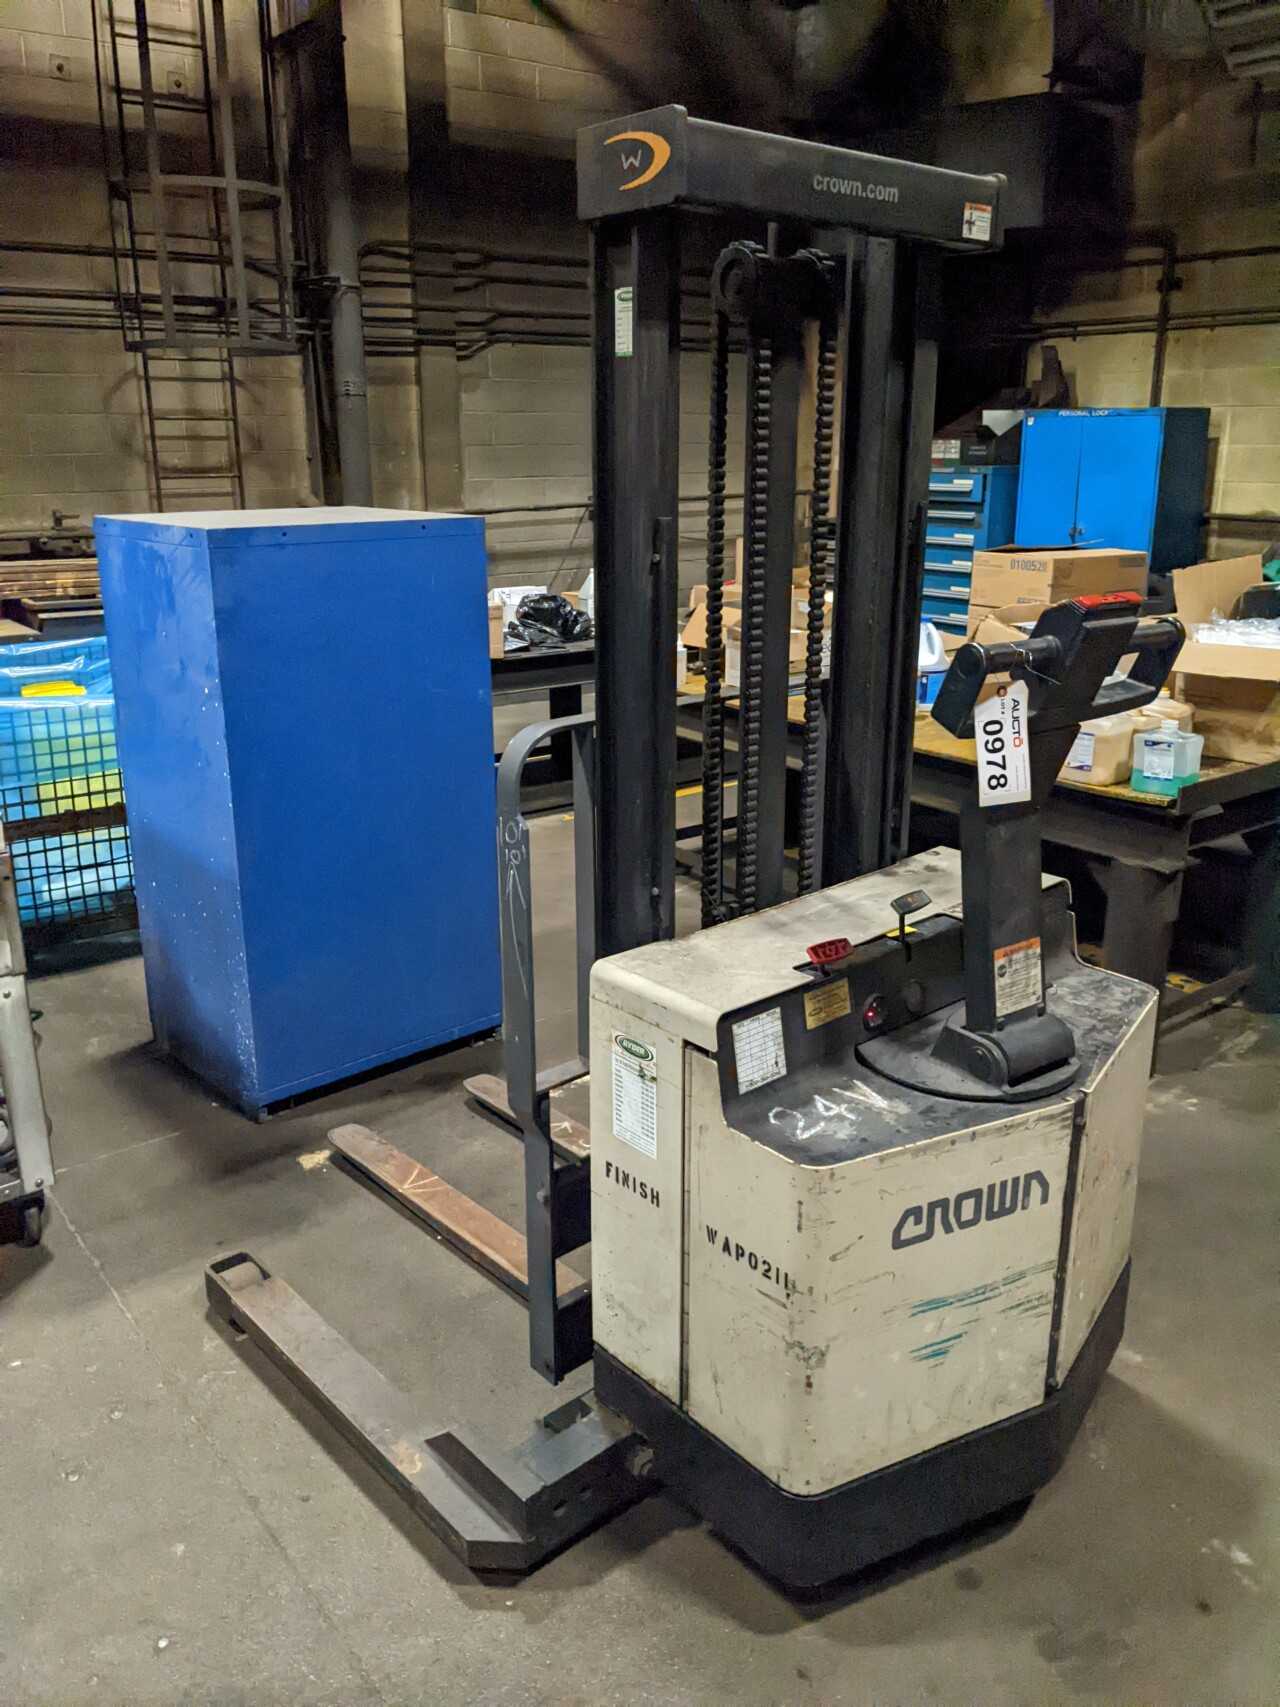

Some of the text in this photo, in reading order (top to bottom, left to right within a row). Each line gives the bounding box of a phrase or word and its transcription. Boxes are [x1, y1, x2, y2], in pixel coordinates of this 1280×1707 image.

[813, 174, 899, 203] crown.com
[983, 720, 1008, 791] 0978
[605, 1161, 660, 1208] FINISH
[892, 1170, 1050, 1250] CROWN
